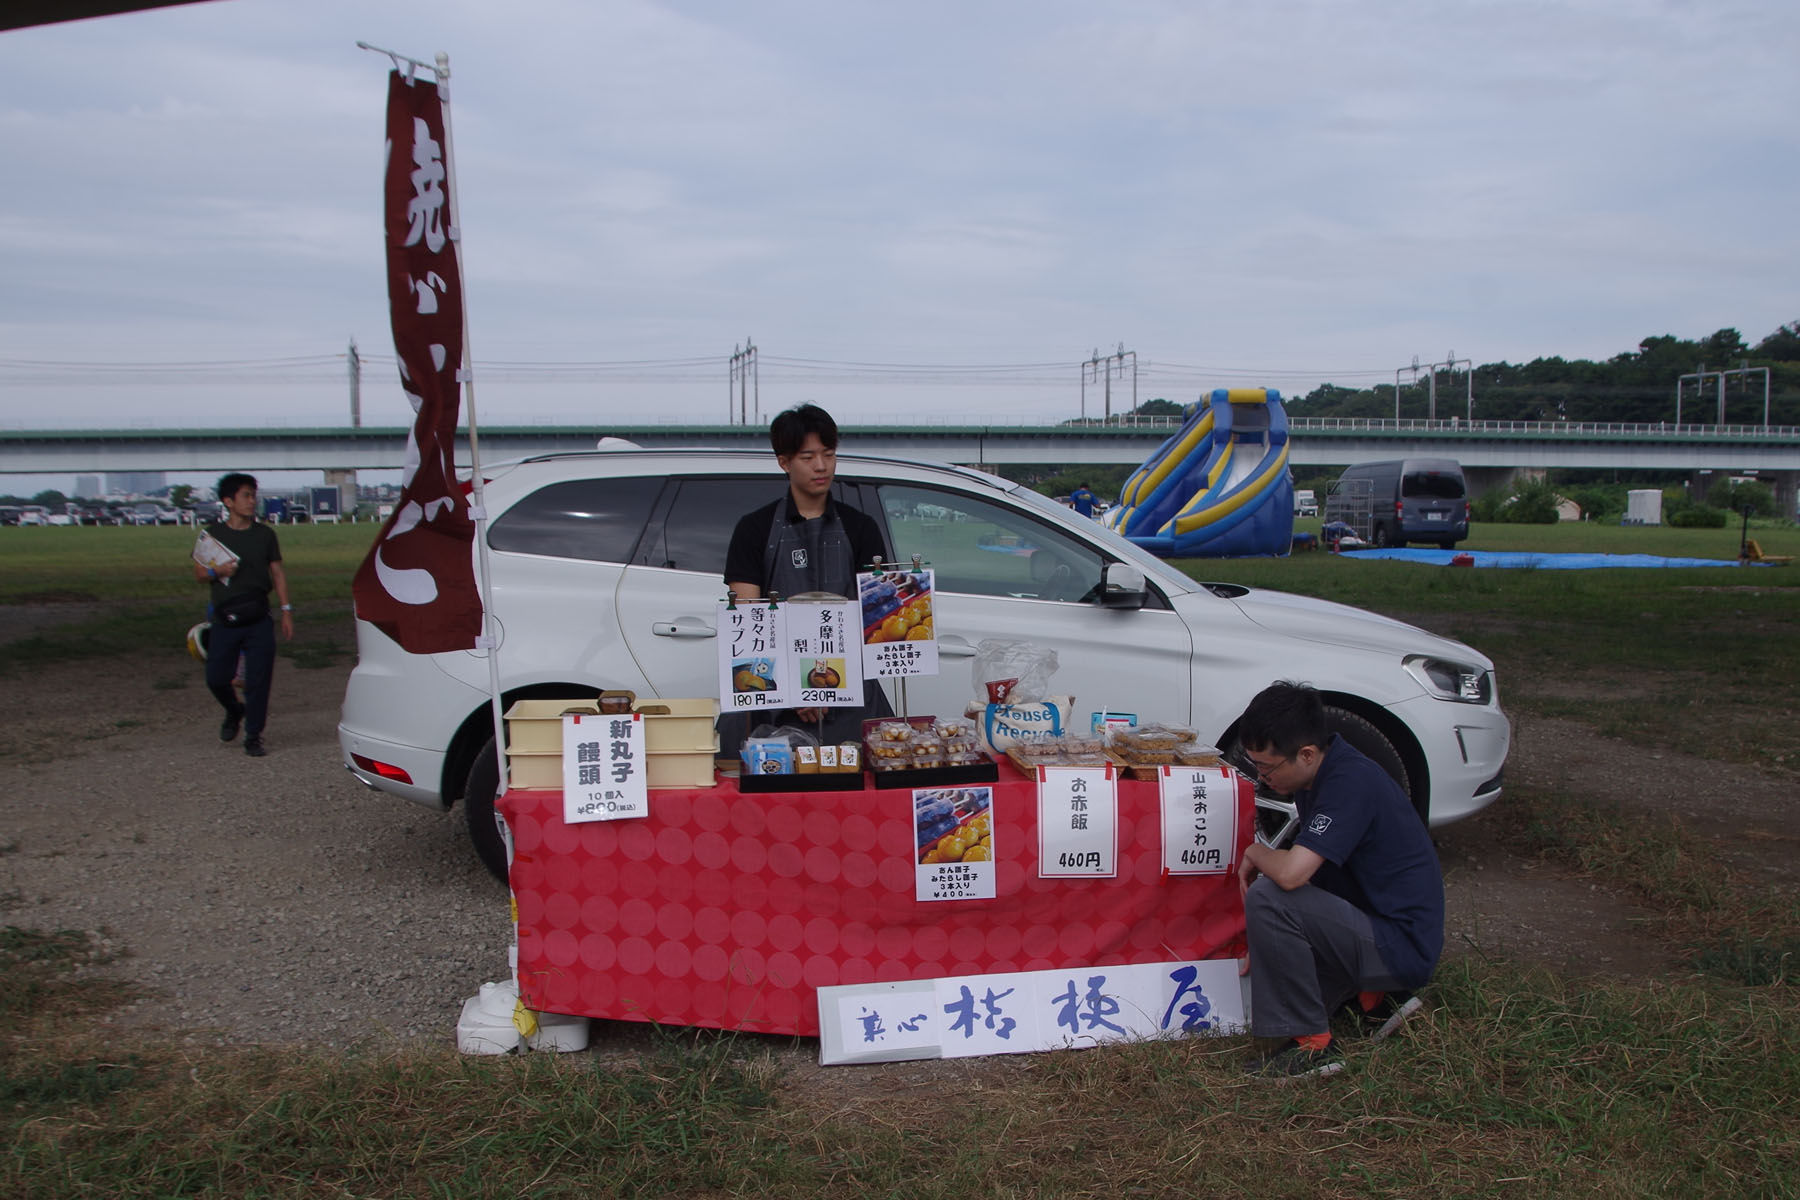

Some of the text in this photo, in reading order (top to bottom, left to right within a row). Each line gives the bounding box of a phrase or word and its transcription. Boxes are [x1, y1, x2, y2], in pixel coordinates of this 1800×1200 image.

[731, 614, 745, 658] サブレ
[750, 607, 765, 653] 等々力
[794, 639, 808, 653] 梨
[820, 609, 833, 654] 多摩川
[801, 690, 836, 703] 230円
[609, 719, 634, 783] 新丸子
[996, 720, 1065, 741] Recyce
[577, 741, 601, 785] 饅頭
[588, 790, 624, 801] 10個入
[1071, 777, 1088, 831] お赤飯
[1191, 771, 1208, 847] 山菜おこわ
[1058, 851, 1101, 868] 460円
[1181, 848, 1221, 865] 460円
